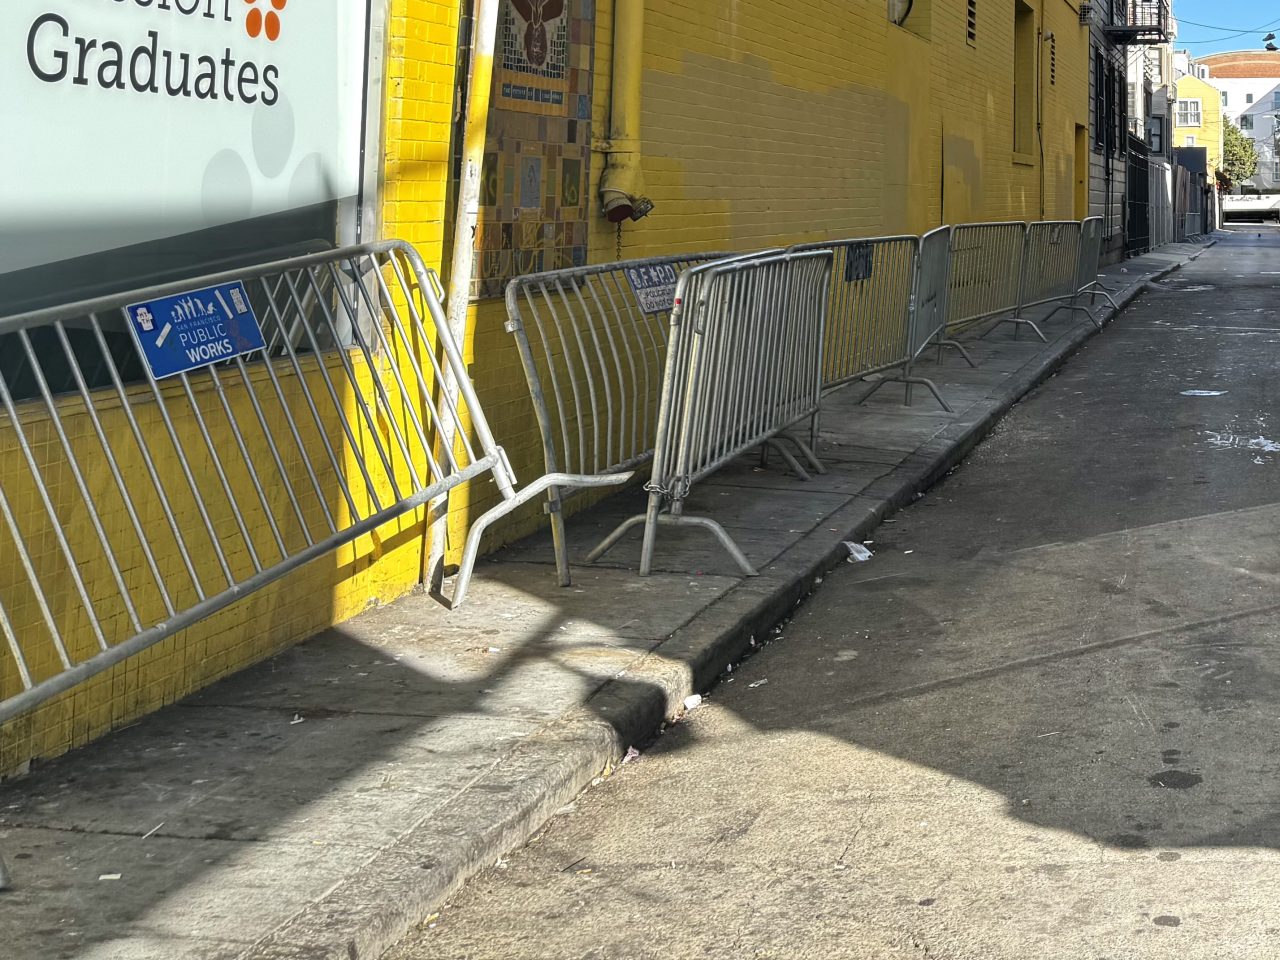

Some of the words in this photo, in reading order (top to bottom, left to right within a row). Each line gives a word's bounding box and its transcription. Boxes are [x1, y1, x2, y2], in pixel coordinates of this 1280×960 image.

[26, 12, 279, 106] Graduates
[179, 323, 227, 347] PUBLIC
[185, 339, 233, 363] WORKS
